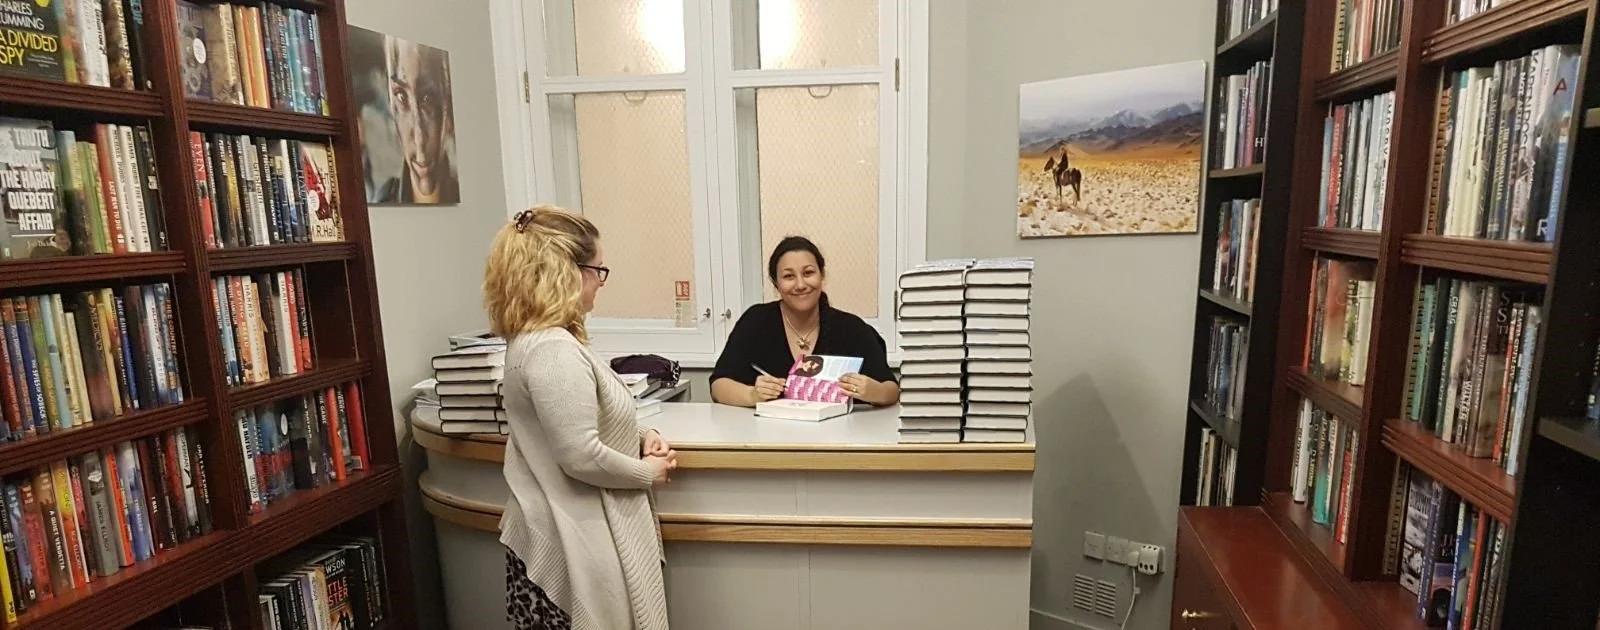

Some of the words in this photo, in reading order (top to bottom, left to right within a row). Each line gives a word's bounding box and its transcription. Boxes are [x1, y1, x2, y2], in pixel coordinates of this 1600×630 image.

[0, 0, 32, 16] HARLES
[0, 12, 44, 30] UMMING
[8, 30, 58, 52] DIVIDED
[0, 45, 24, 66] SPY
[13, 128, 50, 147] TRUTH
[194, 144, 205, 172] EVEN
[0, 170, 22, 188] THE
[20, 170, 56, 190] HARRY
[8, 191, 54, 210] QUEBERT
[18, 212, 54, 230] AFFAIR
[235, 290, 246, 319] DYING
[244, 284, 254, 318] HARRIS
[1450, 296, 1458, 324] CRAIG
[32, 369, 41, 386] SPIES
[35, 393, 46, 419] SOBECK
[1460, 380, 1472, 420] WALTER
[50, 517, 59, 536] QUIET
[53, 536, 65, 570] VENDETTA
[326, 558, 346, 574] WSON
[328, 576, 348, 594] TTLE
[328, 588, 349, 606] STER
